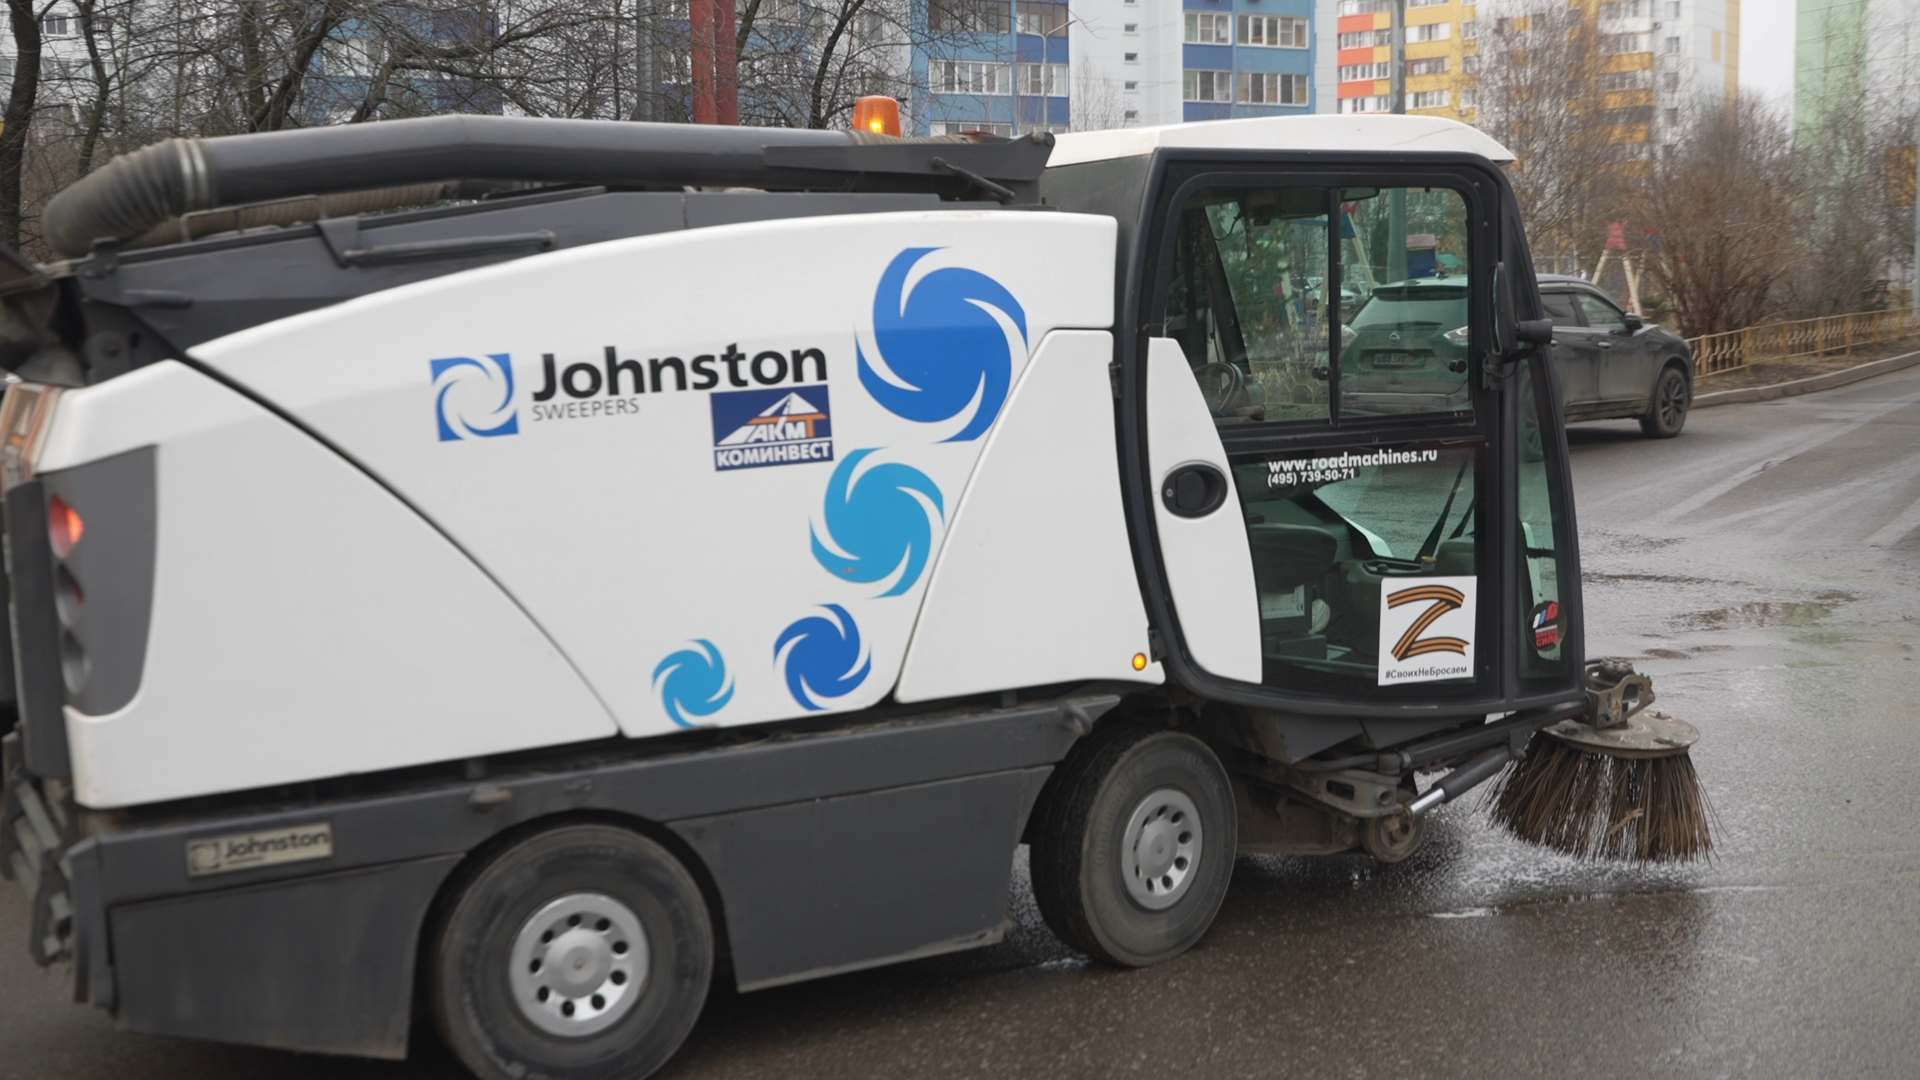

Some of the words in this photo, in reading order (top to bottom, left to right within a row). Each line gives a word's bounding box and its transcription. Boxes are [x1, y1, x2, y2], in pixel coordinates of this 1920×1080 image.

[532, 343, 828, 402] Johnston
[532, 398, 640, 422] SWEEPERS
[716, 442, 832, 468] КОМИНВЕСТ
[1268, 449, 1438, 473] www.roadmachines.ru
[1267, 473, 1297, 487] (495)
[1301, 468, 1355, 483] 739-50-71
[1387, 585, 1470, 662] Z
[1385, 666, 1468, 680] #СвоихНеБросаем
[227, 832, 328, 857] Johnston
